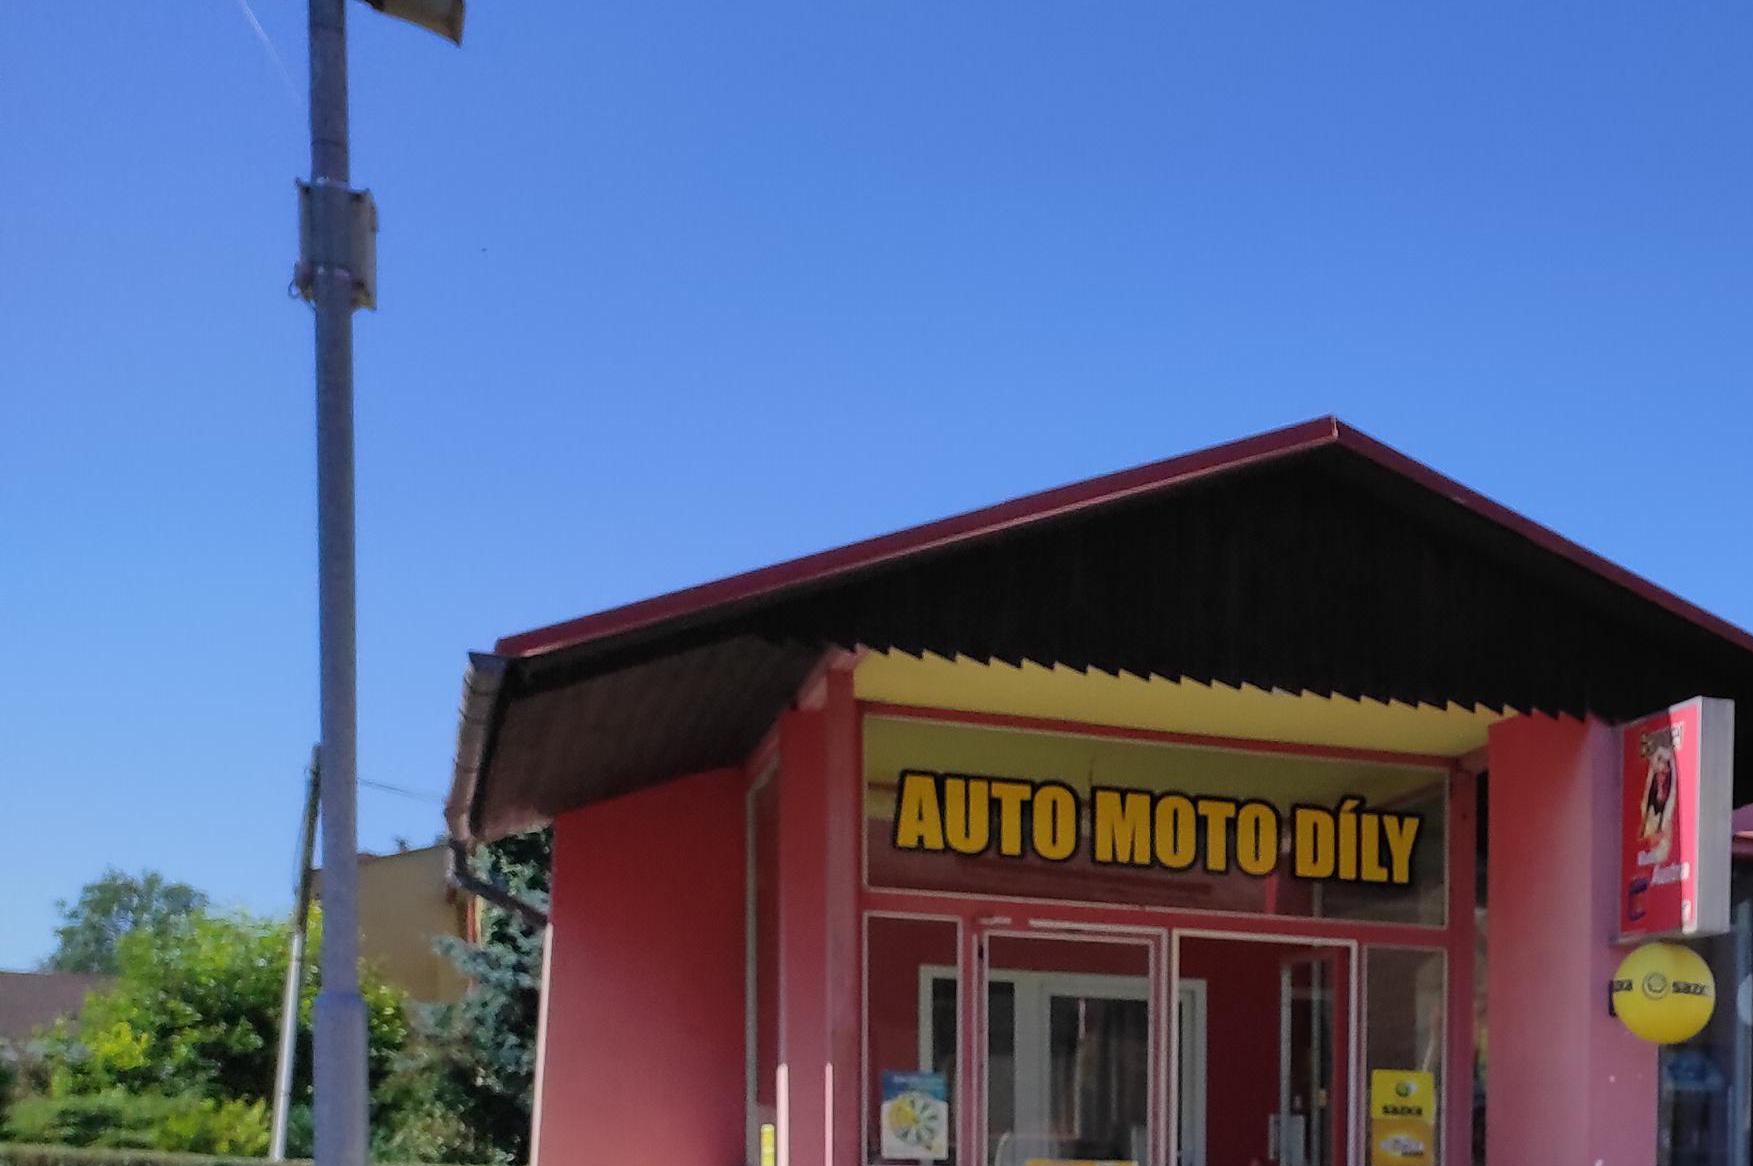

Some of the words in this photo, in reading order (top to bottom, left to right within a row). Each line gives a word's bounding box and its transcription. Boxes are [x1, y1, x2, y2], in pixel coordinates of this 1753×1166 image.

[895, 772, 1080, 862] AUTO
[1091, 788, 1281, 878] MOTO
[1292, 796, 1422, 886] DÍLY
